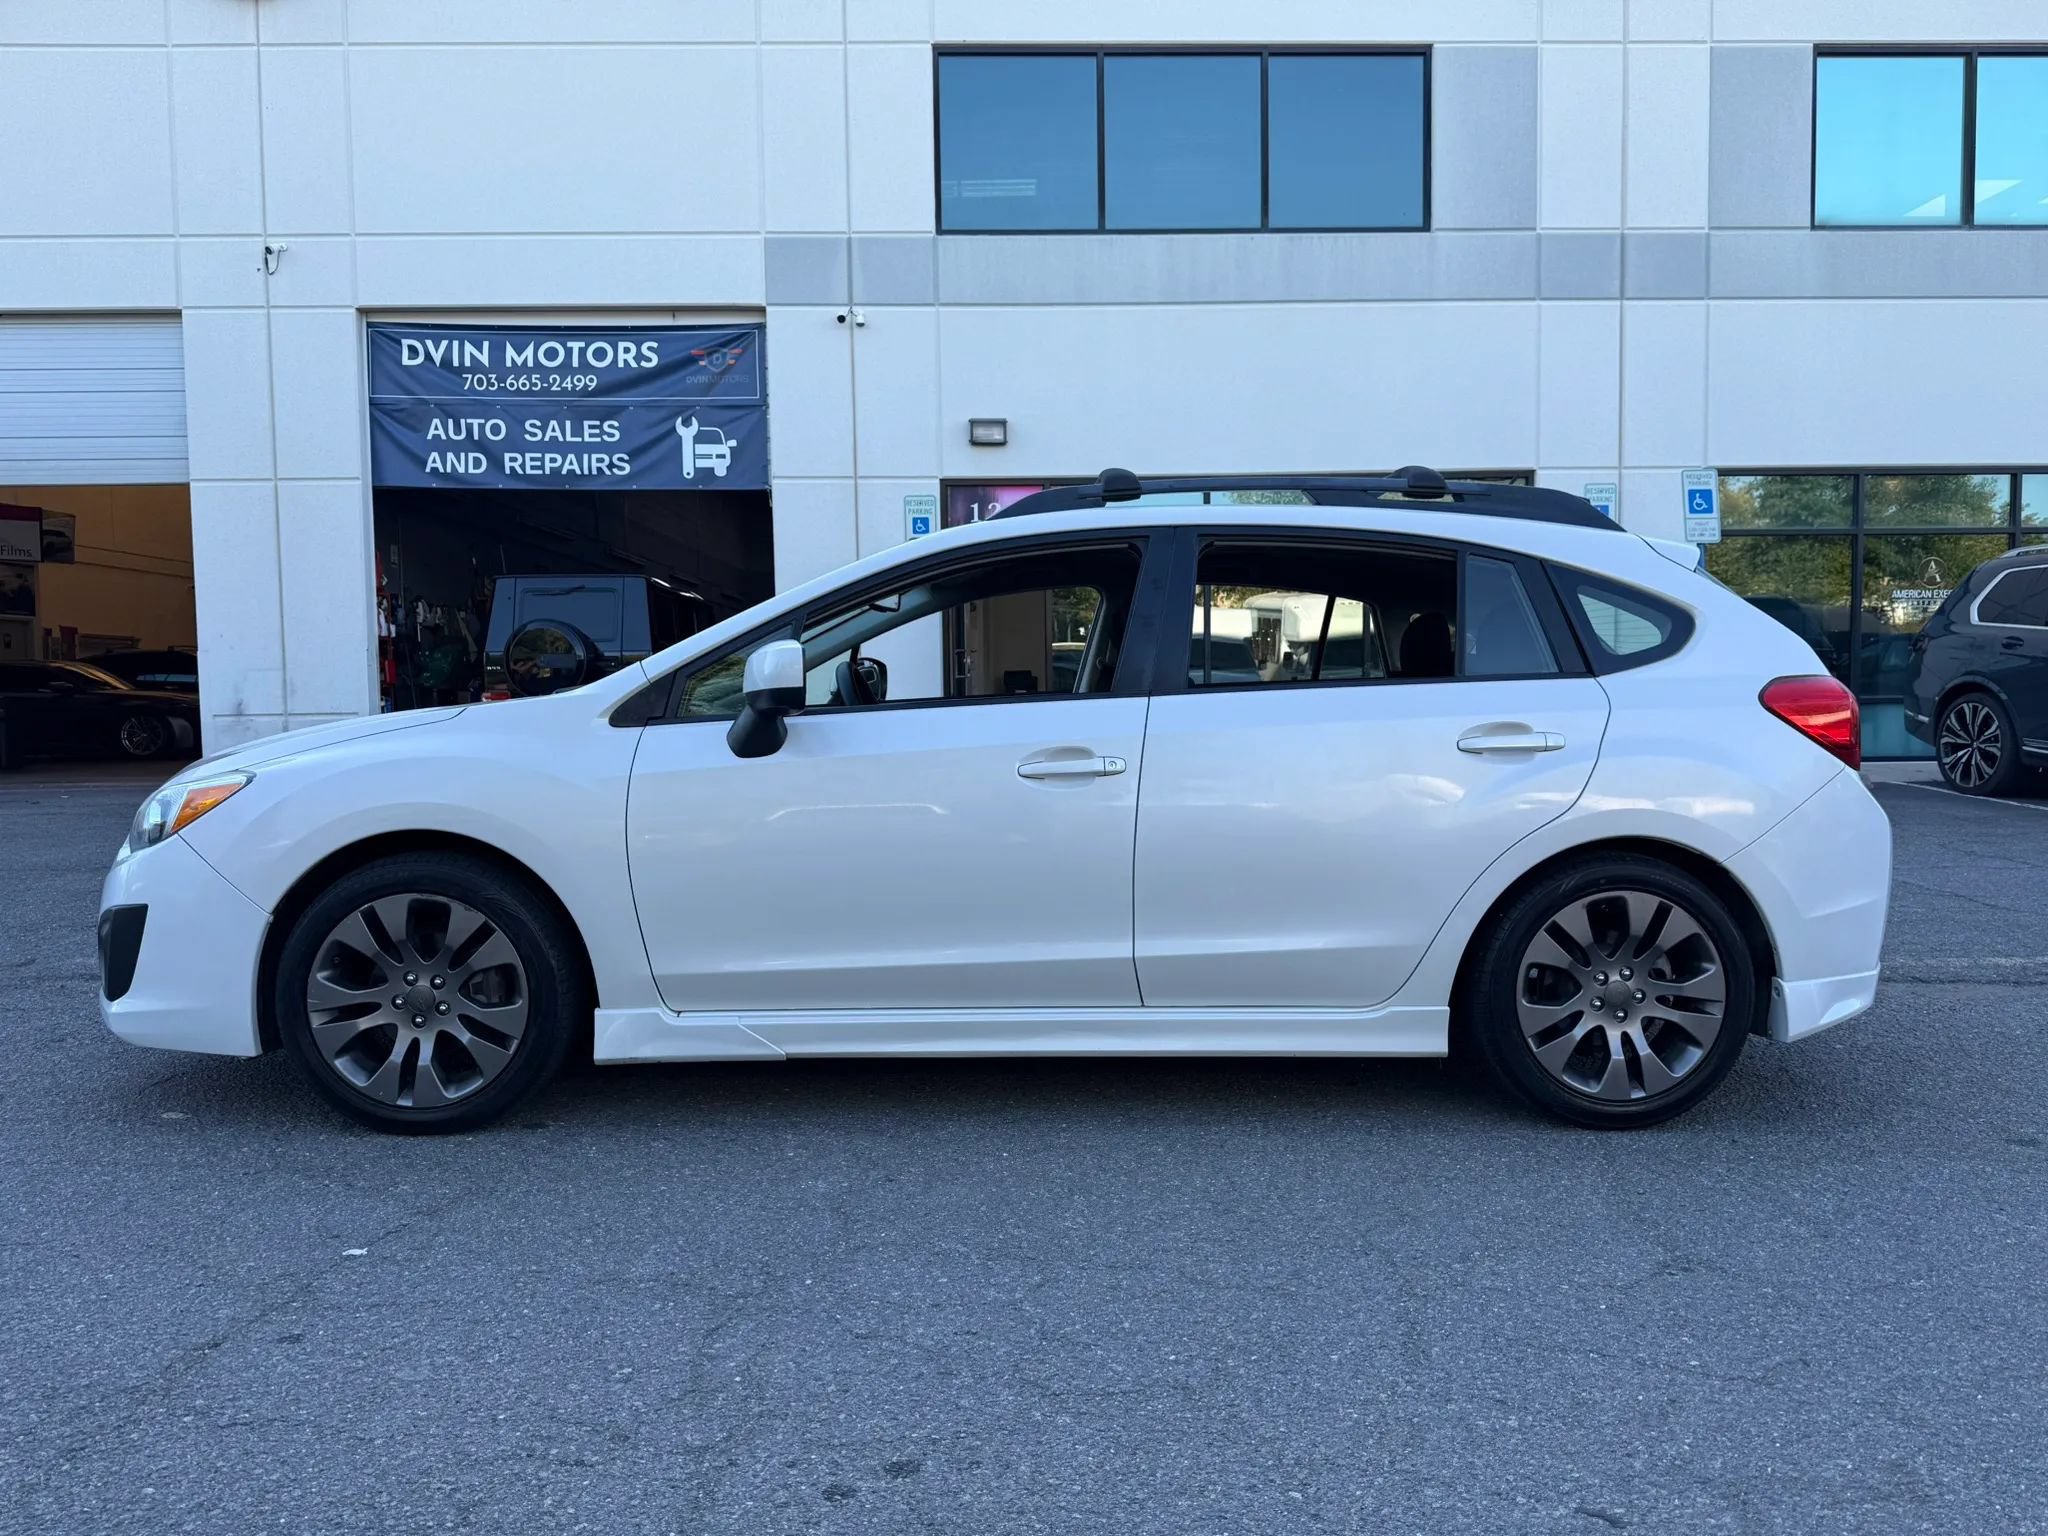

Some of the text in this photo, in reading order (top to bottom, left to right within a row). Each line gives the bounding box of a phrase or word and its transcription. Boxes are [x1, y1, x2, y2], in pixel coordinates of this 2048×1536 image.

[401, 338, 659, 368] DVIN MOTORS
[462, 374, 598, 392] 703-665-2499
[426, 418, 620, 442] AUTO SALES
[425, 452, 631, 476] AND REPAIRS
[905, 499, 934, 507] RESERVED
[0, 545, 33, 558] Films
[1892, 589, 1932, 598] AMERICAN
